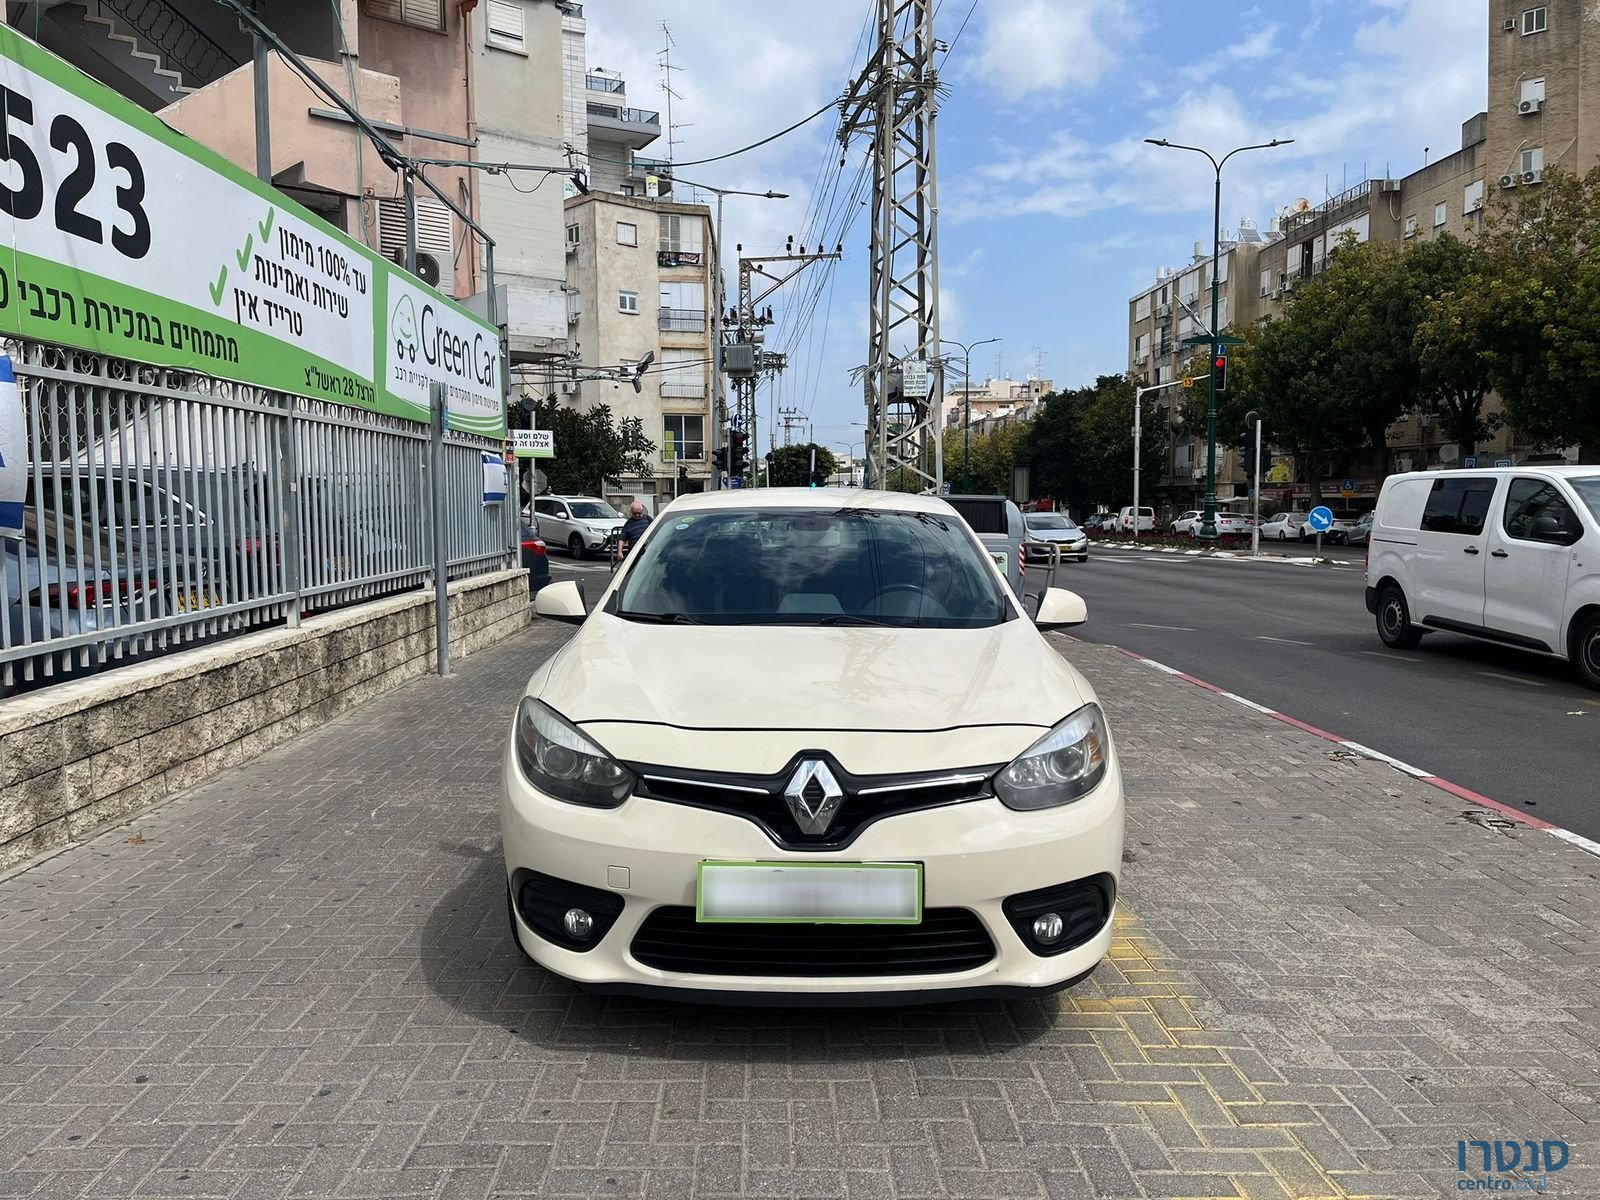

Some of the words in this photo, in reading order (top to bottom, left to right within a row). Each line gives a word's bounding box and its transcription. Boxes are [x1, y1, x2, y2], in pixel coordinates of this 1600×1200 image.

[0, 84, 150, 260] 523
[279, 226, 315, 268] מימון
[318, 246, 350, 286] 100%
[254, 254, 310, 302] ואמינות
[352, 267, 366, 295] עד
[17, 279, 77, 326] רכבי
[234, 288, 260, 325] אין
[263, 298, 303, 337] טרייד
[312, 281, 349, 319] שירות
[84, 296, 165, 347] במכירת
[170, 319, 239, 364] מתמחים
[421, 304, 472, 380] Green
[474, 332, 496, 389] Car
[342, 376, 354, 398] 28
[355, 379, 375, 403] הרצל
[394, 366, 407, 382] רכב
[533, 432, 549, 440] שלם
